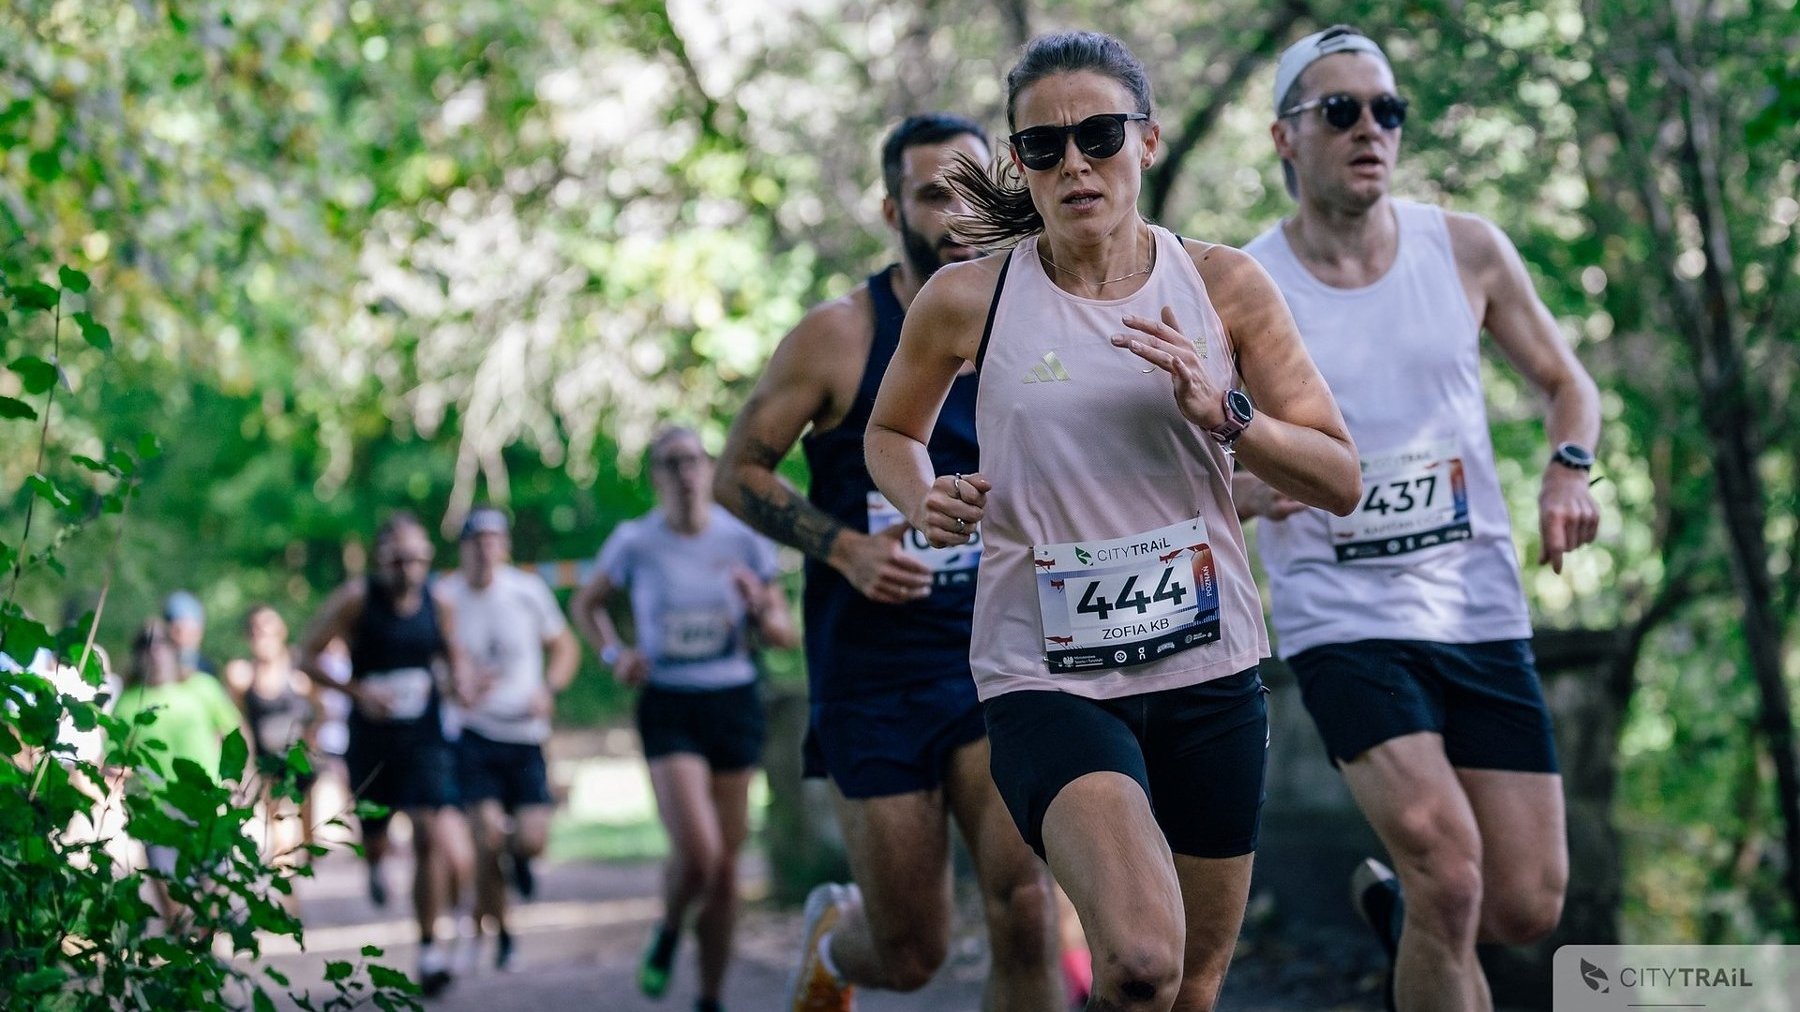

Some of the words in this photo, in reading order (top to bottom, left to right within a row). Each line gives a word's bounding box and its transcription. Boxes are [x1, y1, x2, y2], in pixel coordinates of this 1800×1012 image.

[1363, 475, 1436, 515] 437
[1076, 567, 1187, 619] 444
[1202, 565, 1212, 597] POZNAŃ
[1102, 623, 1147, 639] ZOFIA
[1150, 618, 1169, 632] KB
